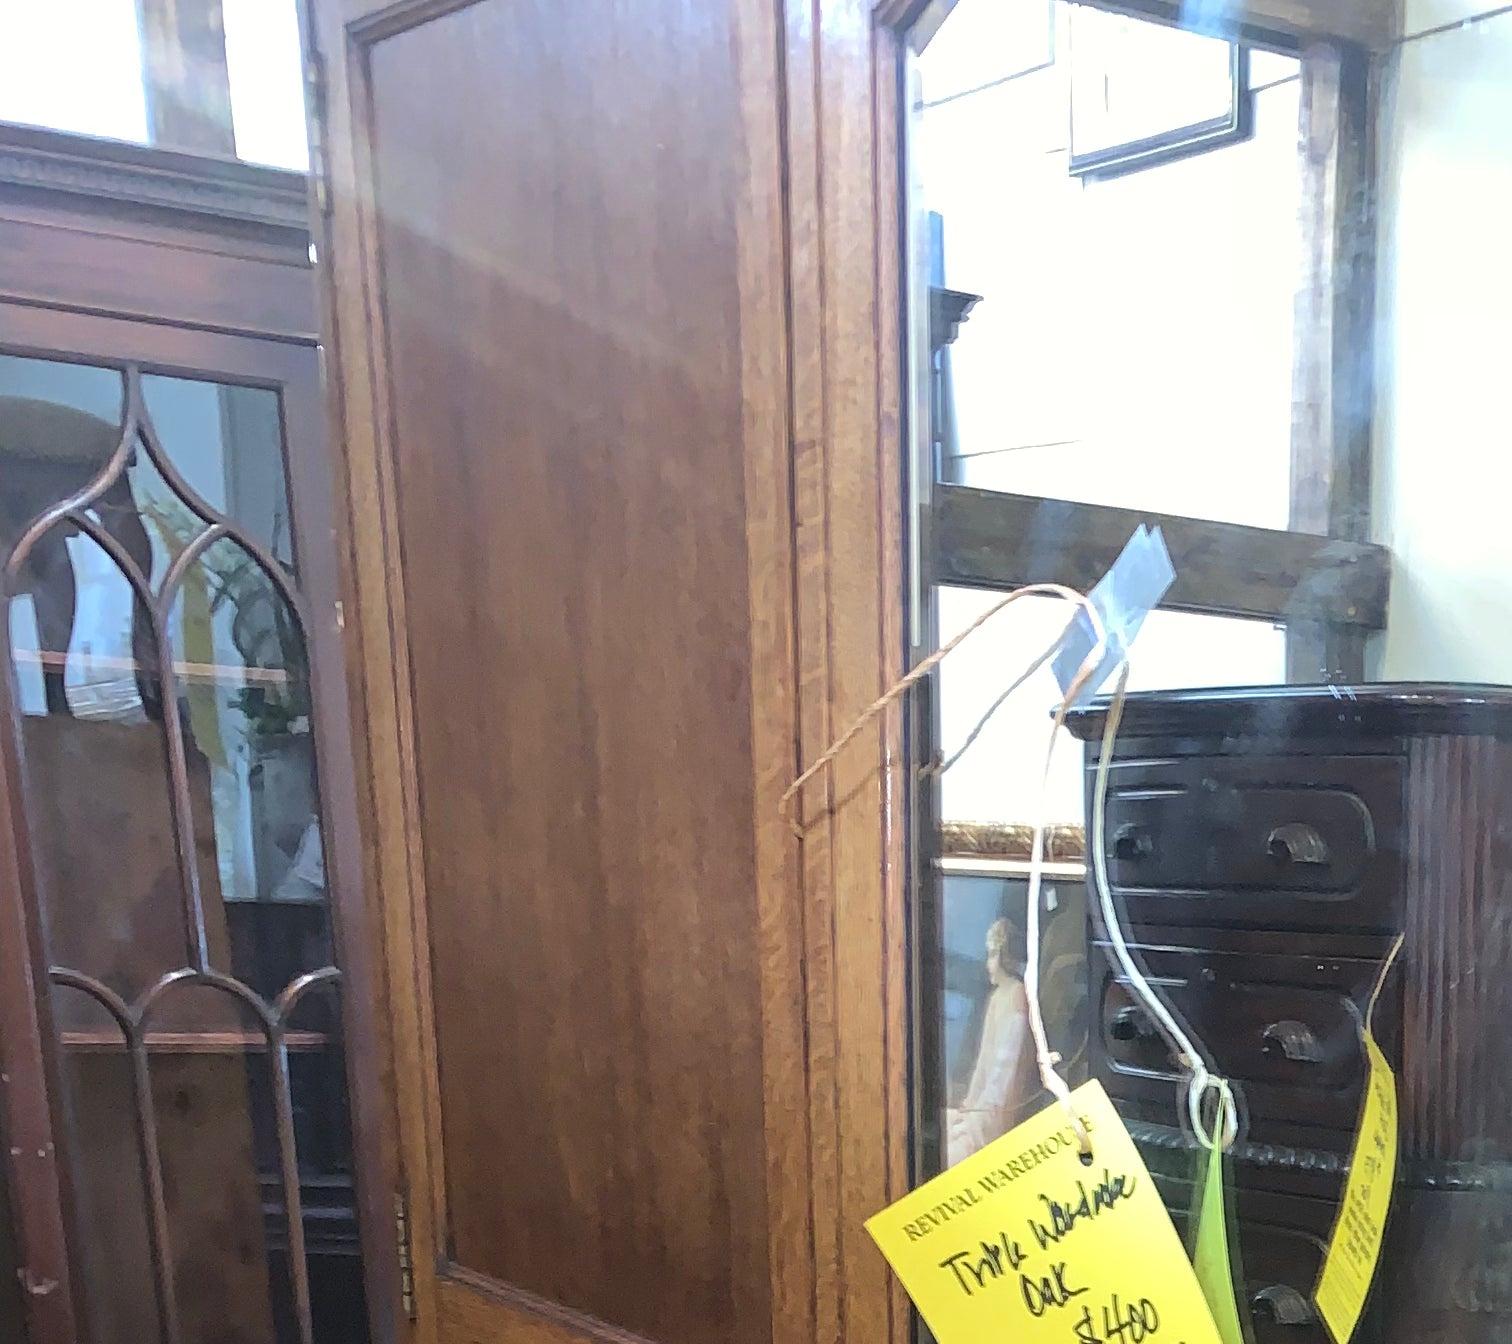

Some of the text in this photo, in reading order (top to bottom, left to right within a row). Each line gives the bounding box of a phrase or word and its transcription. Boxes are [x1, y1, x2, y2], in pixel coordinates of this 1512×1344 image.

[902, 1115, 1094, 1242] REVIVAL WAREHOUE
[1019, 1262, 1090, 1317] Oak
